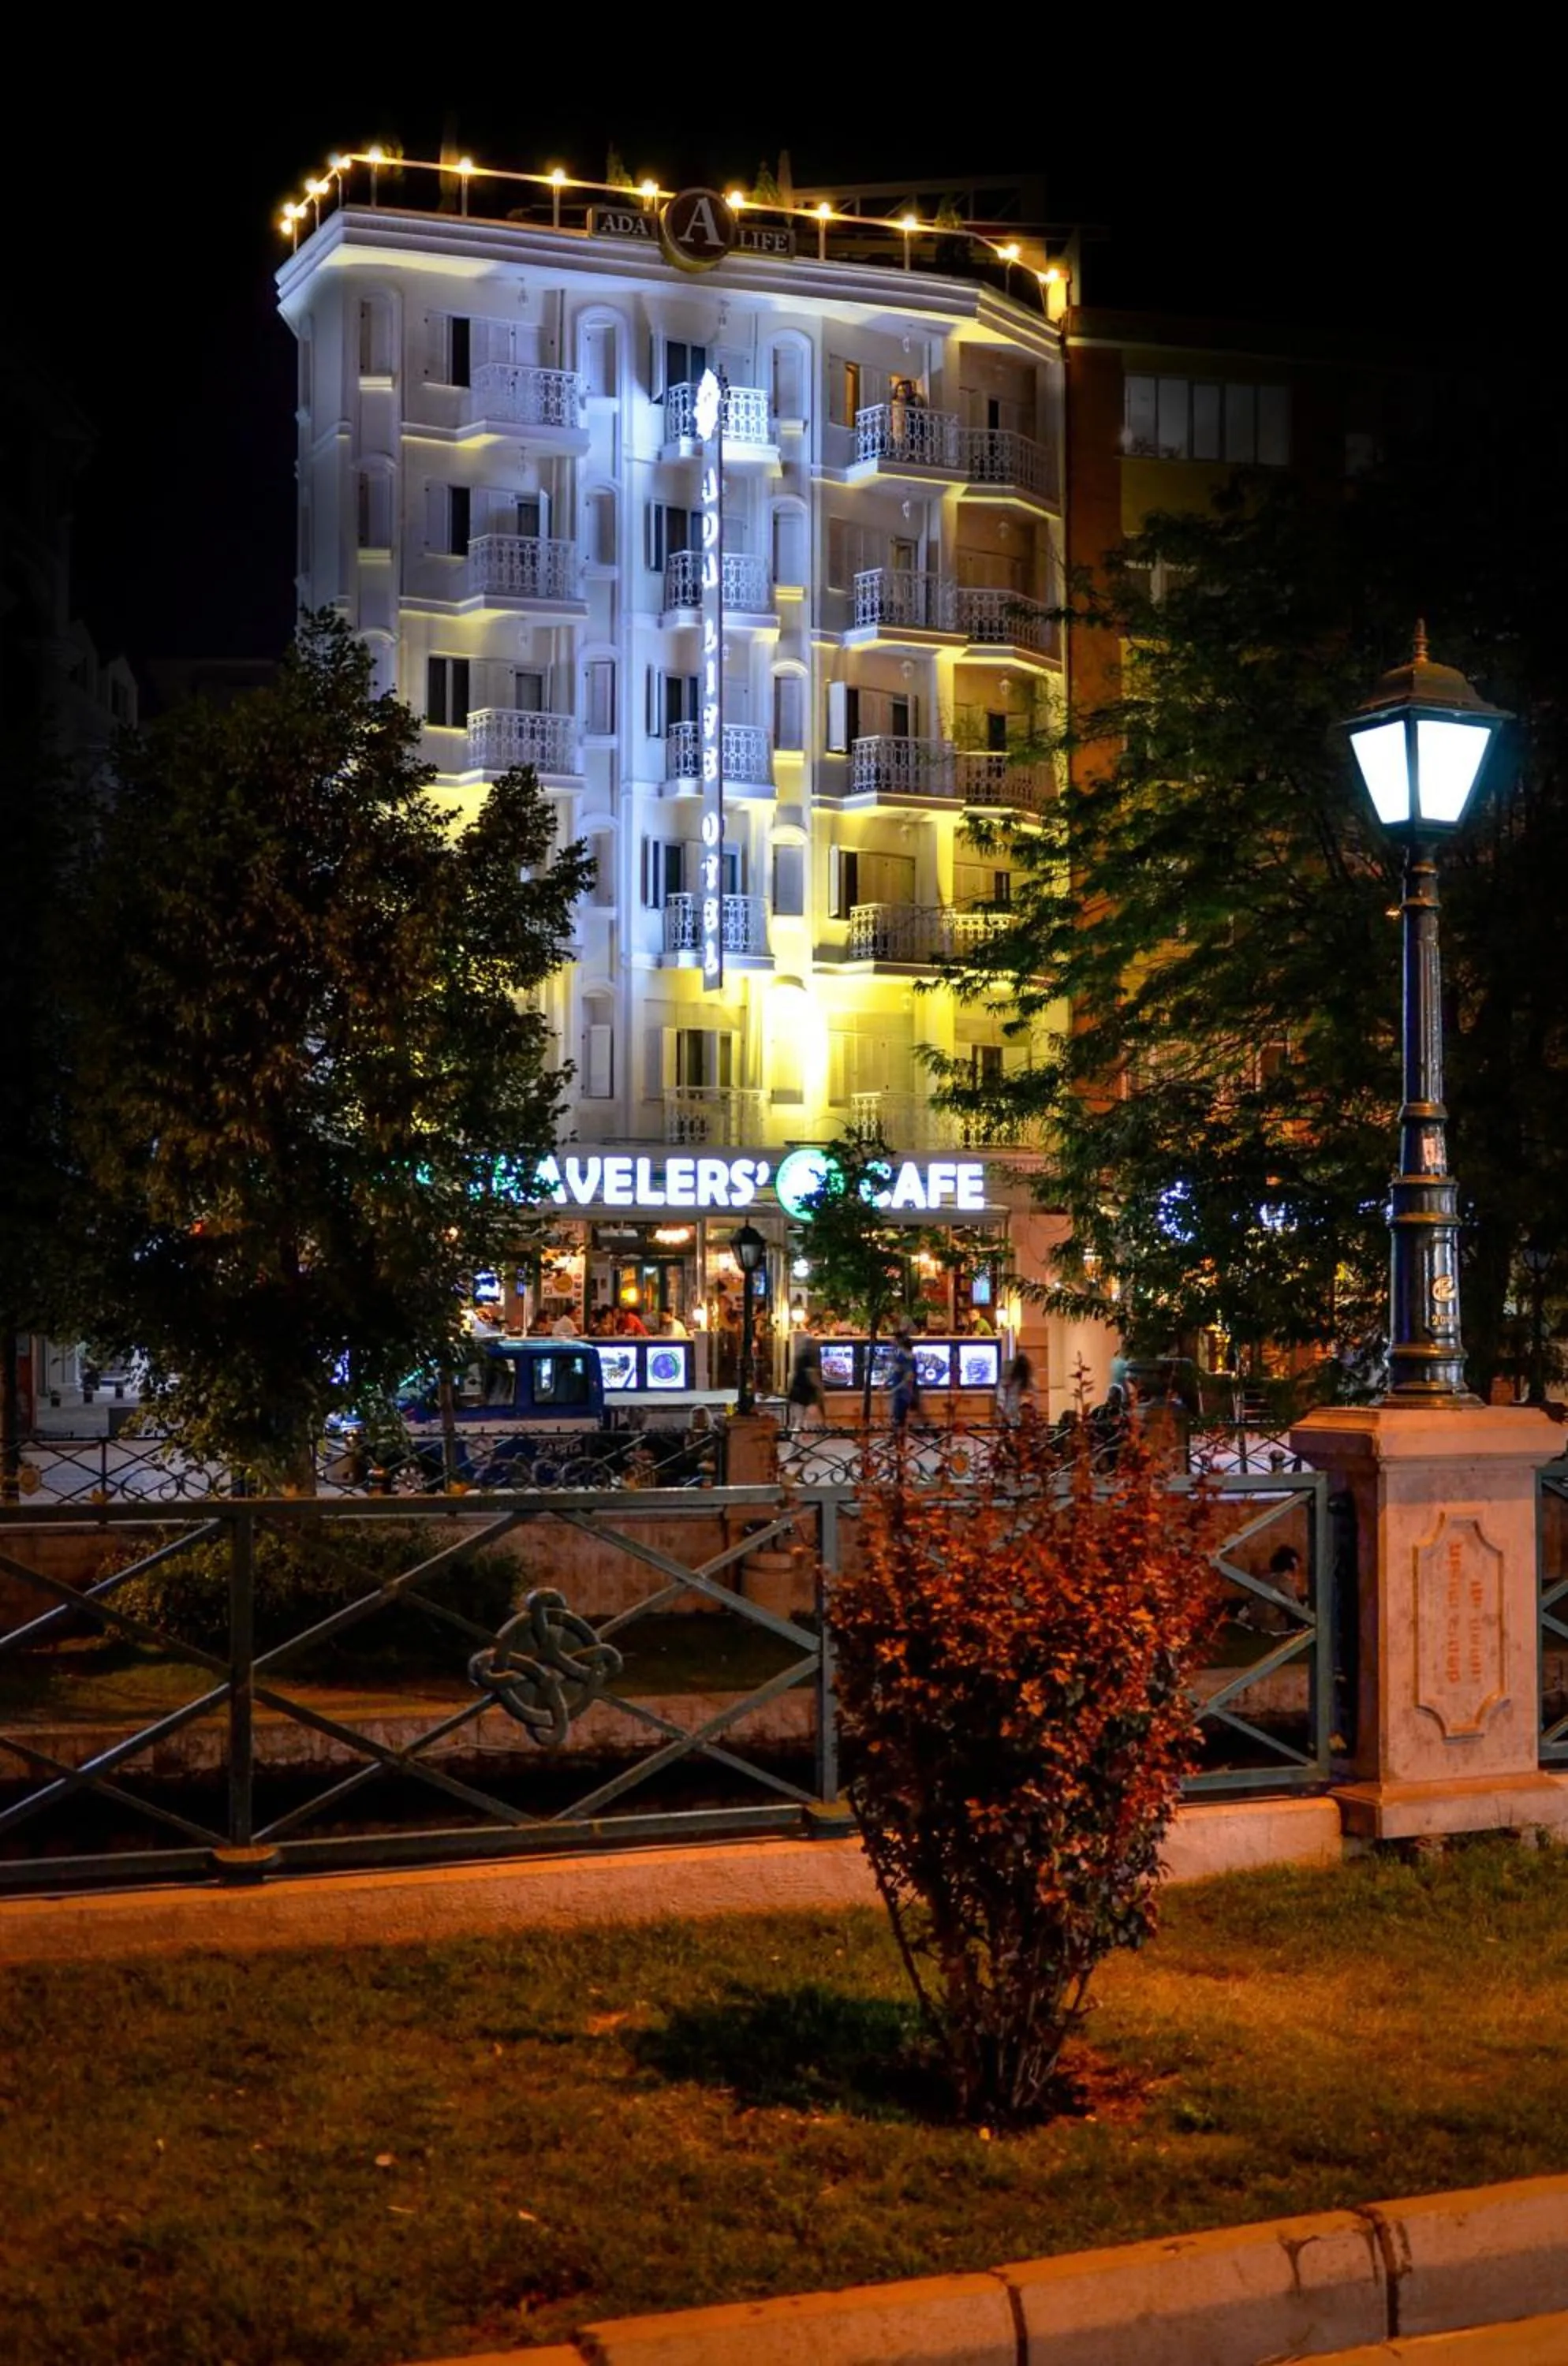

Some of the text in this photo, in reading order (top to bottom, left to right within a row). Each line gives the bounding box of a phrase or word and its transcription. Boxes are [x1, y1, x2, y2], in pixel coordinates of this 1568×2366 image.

[600, 214, 788, 253] ADA LIFE
[678, 196, 725, 246] A
[465, 1155, 770, 1207] AVELERS'
[859, 1160, 986, 1210] CAFE
